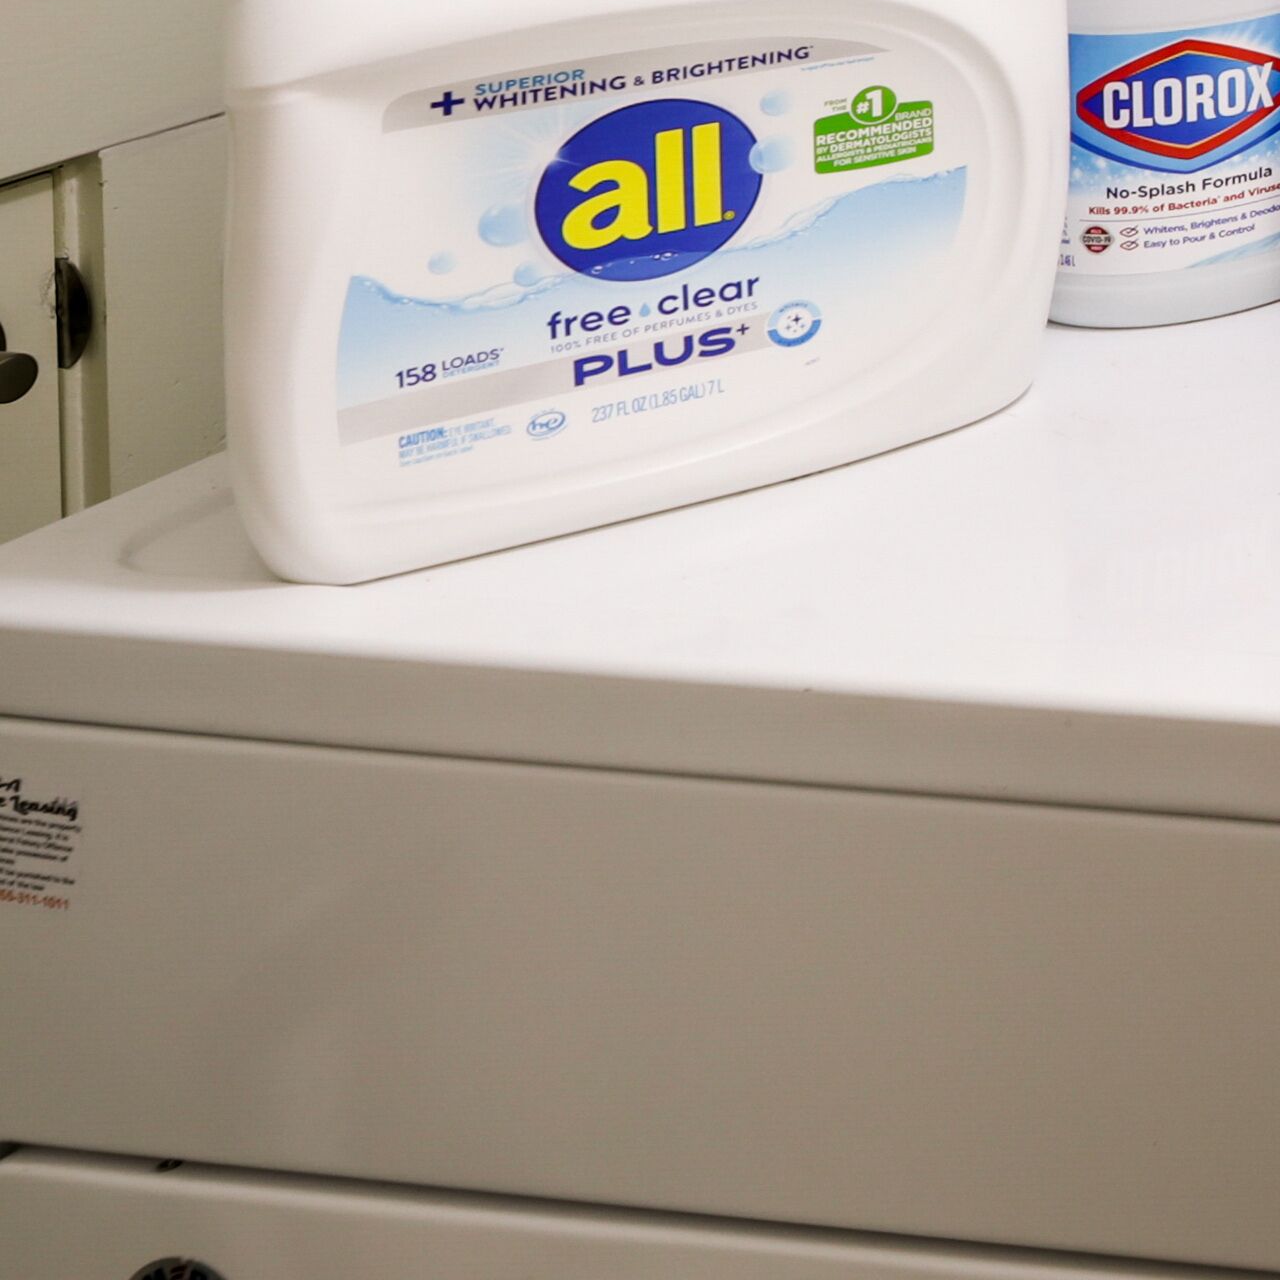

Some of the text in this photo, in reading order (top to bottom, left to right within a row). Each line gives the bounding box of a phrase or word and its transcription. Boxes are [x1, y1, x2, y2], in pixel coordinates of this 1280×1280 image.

[473, 75, 626, 111] WHITENING
[633, 75, 645, 88] &
[652, 46, 811, 85] BRIGHTENING
[474, 68, 585, 96] SUPERIOR
[856, 89, 882, 118] #1
[1103, 61, 1274, 129] CLOROX
[895, 108, 932, 121] BRAND
[816, 117, 932, 145] RECOMMENDED
[816, 128, 932, 155] BY DERMATOLOGISTS
[562, 122, 721, 249] all
[1106, 166, 1272, 199] No-Splash Formula
[1088, 206, 1110, 215] Kills
[1113, 205, 1149, 215] 99.9%
[1152, 203, 1165, 213] of
[1168, 196, 1217, 211] Bacteria
[1223, 191, 1245, 202] and
[1143, 222, 1188, 236] Whitens,
[1190, 214, 1238, 230] Brightens
[1143, 224, 1256, 249] Easy to Pour Control
[1082, 235, 1112, 244] COVID-19
[547, 277, 760, 339] free clear
[551, 301, 758, 353] 100% FREE OF PERFUMES & DYES
[395, 363, 437, 388] 158
[442, 360, 499, 378] DETERGENT
[591, 403, 614, 423] 237
[617, 400, 630, 416] FL
[632, 396, 649, 411] OZ
[680, 383, 706, 402] GAL)
